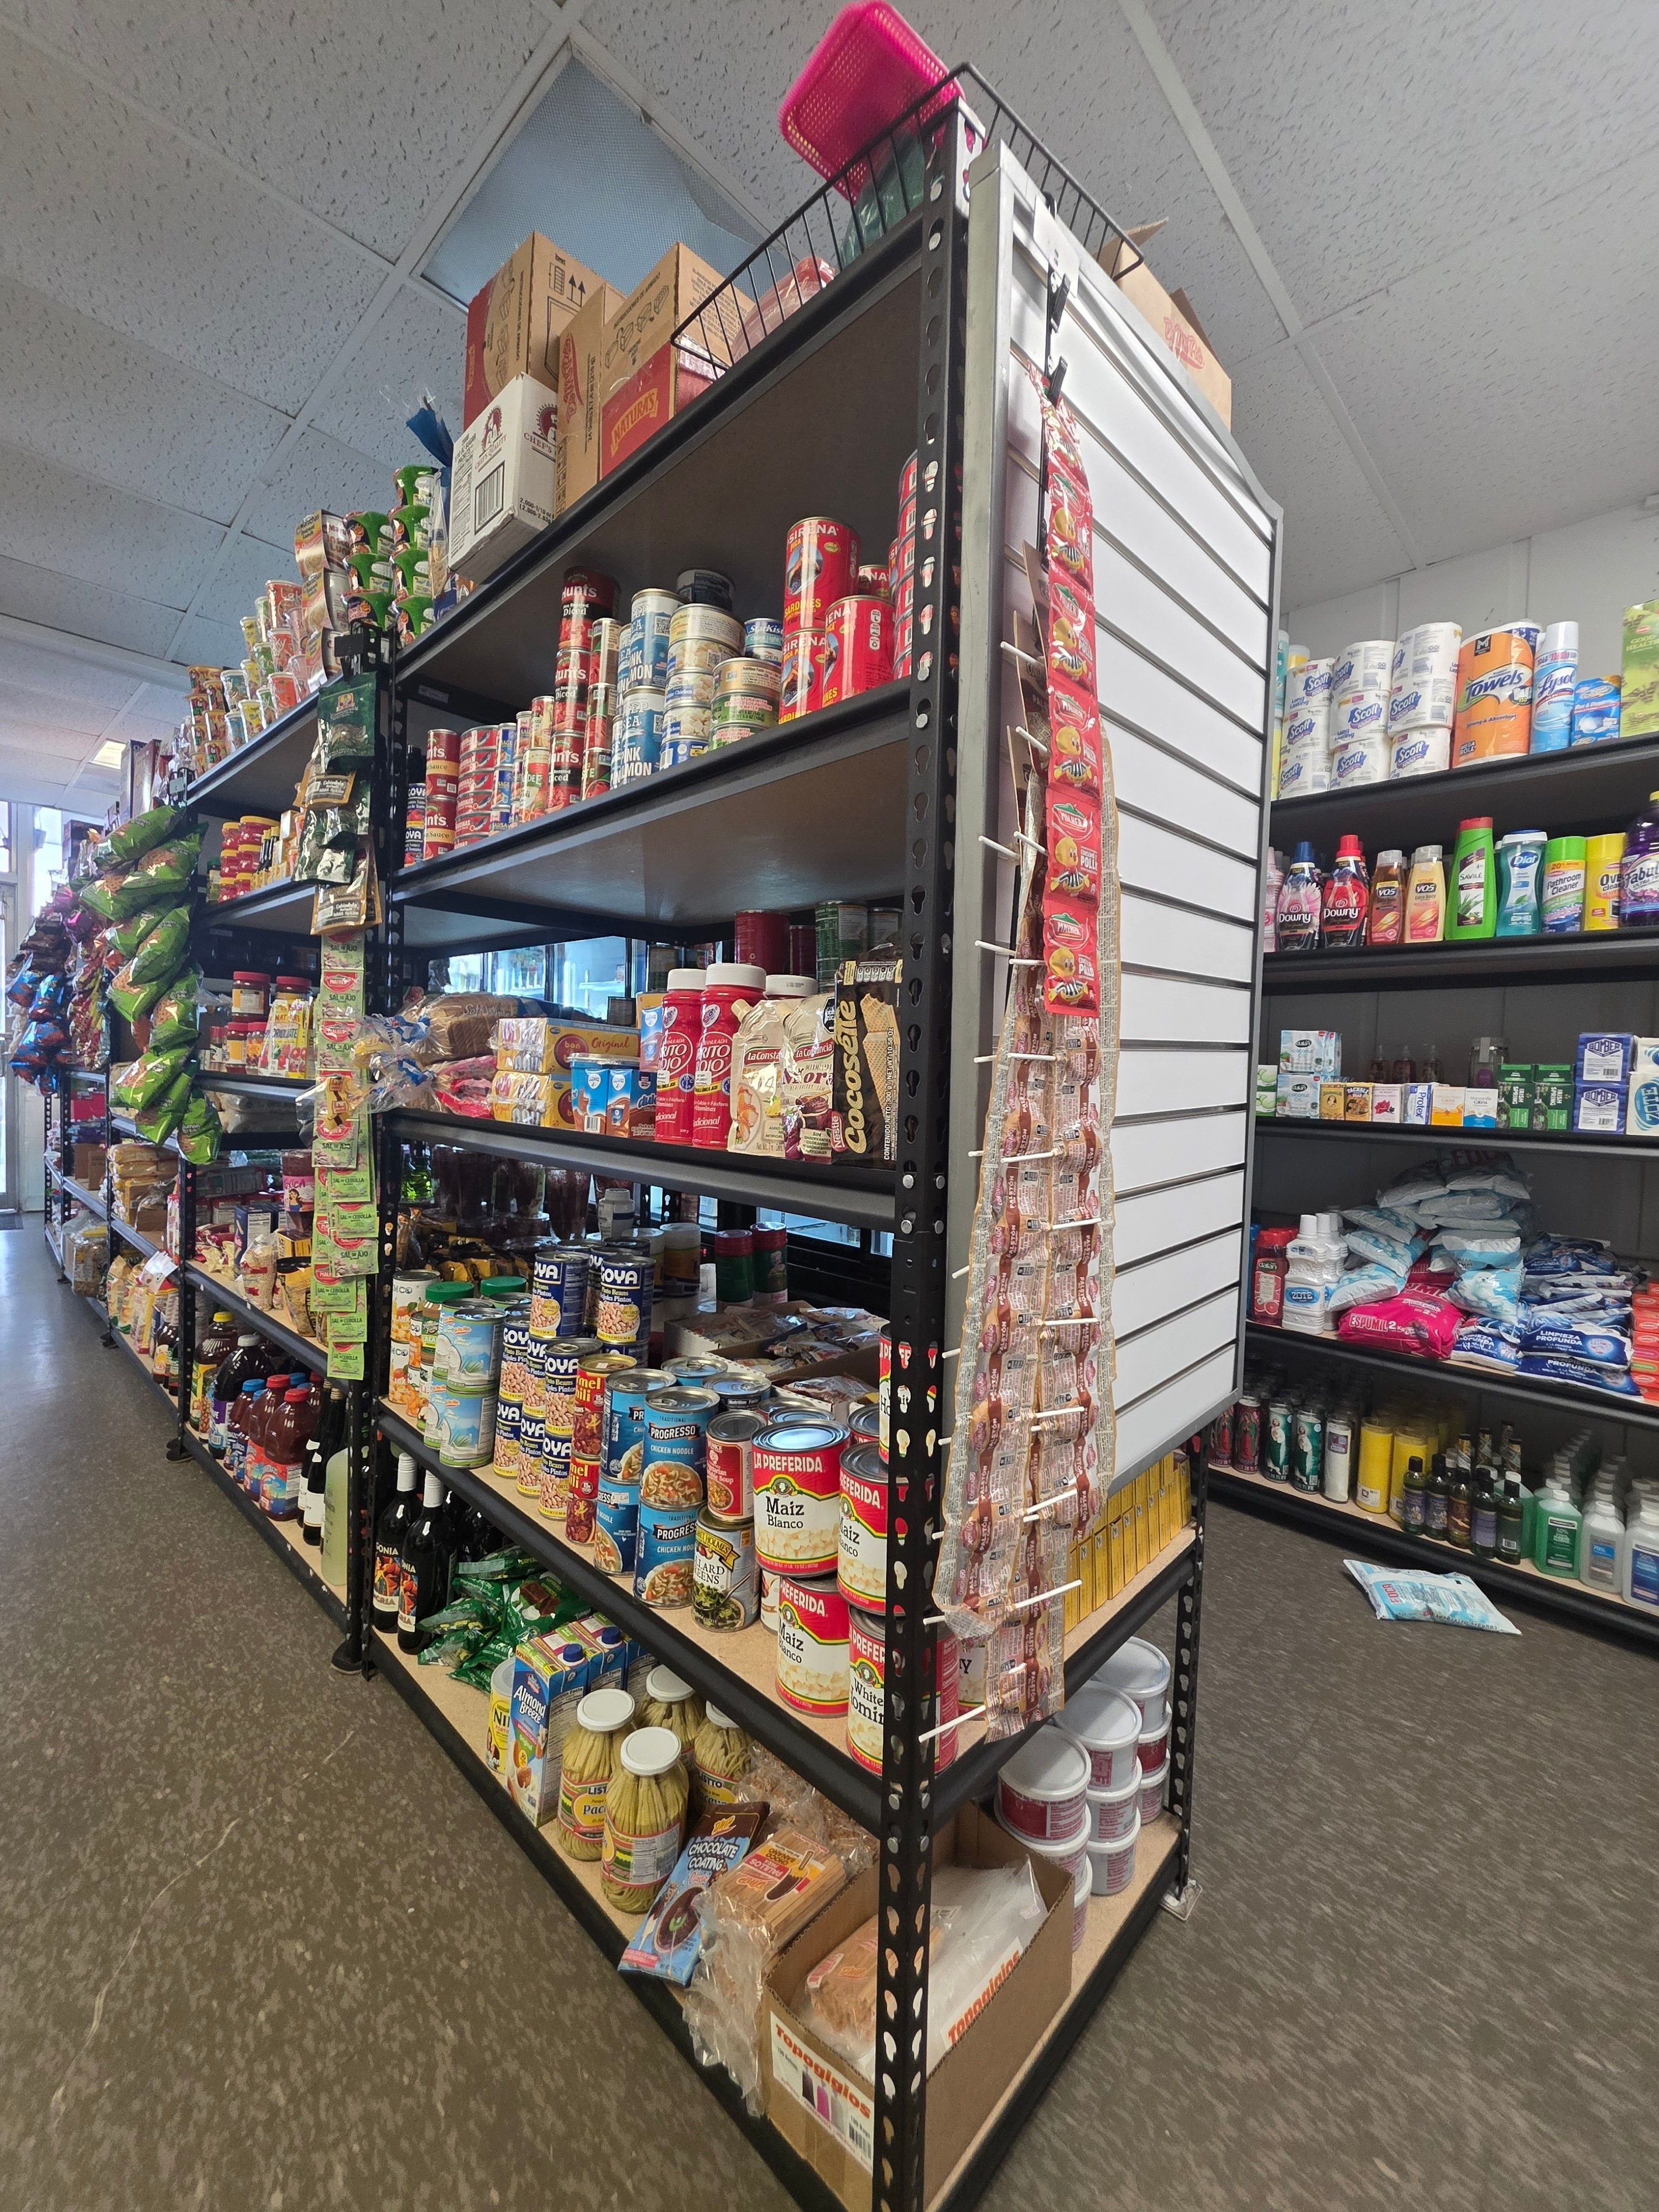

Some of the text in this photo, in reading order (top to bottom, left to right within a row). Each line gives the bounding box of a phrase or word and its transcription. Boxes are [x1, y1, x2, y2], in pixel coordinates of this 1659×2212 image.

[524, 431, 552, 455] CHEF'S
[788, 524, 838, 544] SIRENA
[563, 607, 587, 617] Diced
[1308, 672, 1331, 689] Scott
[1465, 669, 1524, 703] Towels
[1538, 669, 1575, 698] Lysol
[1390, 691, 1419, 715] Scott
[1352, 704, 1378, 722] Scott
[1289, 721, 1312, 738] Scott
[1398, 740, 1426, 763] Scott
[1338, 752, 1364, 772] Scott
[405, 831, 422, 839] OYA
[1513, 854, 1536, 866] Dial
[1378, 887, 1396, 896] VO5
[1416, 884, 1436, 893] VO5
[1551, 881, 1579, 896] Cleaner
[1279, 912, 1312, 927] Downy
[1323, 906, 1360, 919] Downy
[346, 944, 357, 952] AJO
[564, 1041, 581, 1050] bon
[888, 1056, 893, 1068] WT
[1415, 1092, 1427, 1119] Protex
[536, 1282, 549, 1291] Beans
[536, 1288, 552, 1297] Pintos
[1291, 1291, 1313, 1300] ZOTE
[1349, 1314, 1389, 1332] ESPUMIL
[1388, 1320, 1397, 1329] 2
[503, 1327, 529, 1344] GOY
[1536, 1335, 1583, 1347] PROFUNDA
[1540, 1329, 1580, 1340] LIMPIEZA
[555, 1377, 573, 1386] Beans
[557, 1385, 577, 1393] Pintos
[659, 1415, 687, 1423] TRADITIONAL
[650, 1425, 697, 1439] PROGRESSO
[524, 1441, 539, 1449] Beans
[525, 1446, 542, 1455] Pintos
[650, 1444, 695, 1456] CHICKEN NOODLE
[547, 1460, 565, 1469] Beans
[754, 1451, 823, 1474] LA PREFERIDA
[550, 1467, 568, 1476] Pintos
[767, 1514, 804, 1530] Blanco
[656, 1521, 697, 1541] PROGRESS
[657, 1544, 681, 1553] CHICKEN
[513, 1684, 547, 1719] Almond
[519, 1701, 541, 1724] Breeze
[688, 1841, 739, 1860] CHOCOLATE
[769, 1848, 797, 1864] BANANO
[688, 1856, 724, 1871] COATING
[765, 1853, 789, 1866] CHOCO
[749, 1859, 784, 1878] PALILLOS
